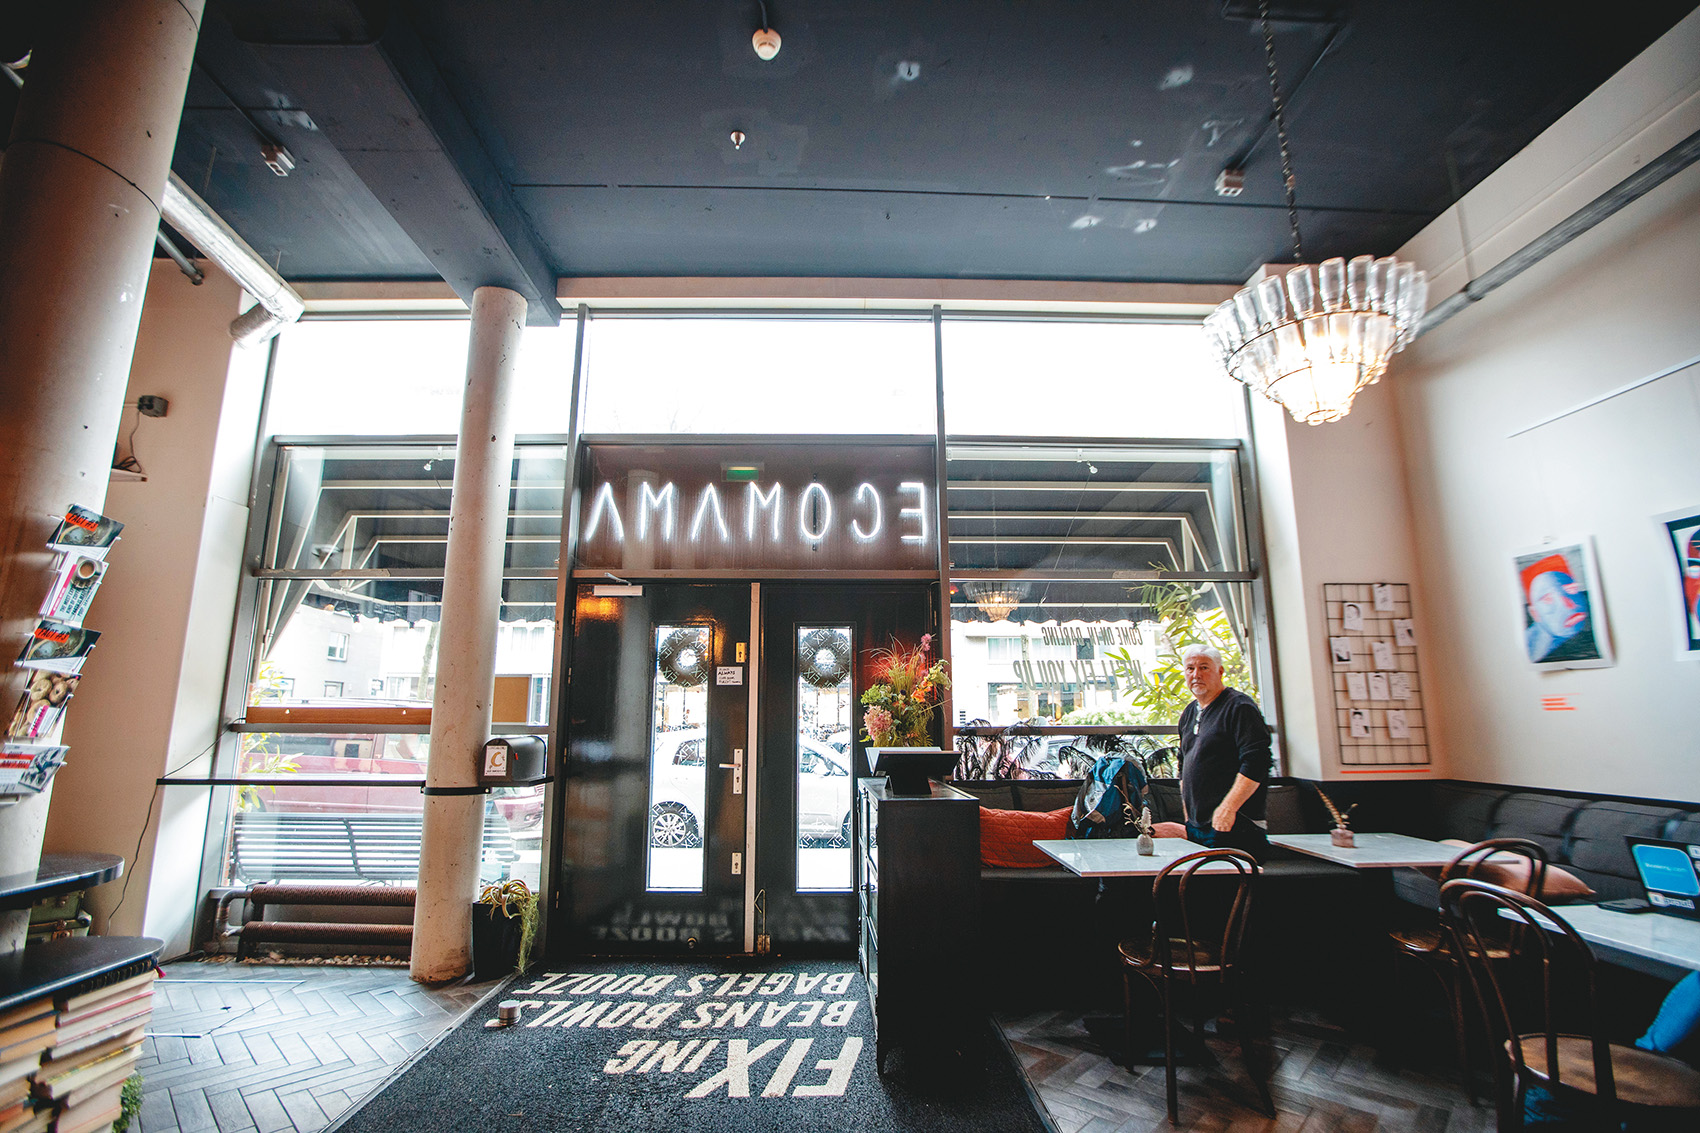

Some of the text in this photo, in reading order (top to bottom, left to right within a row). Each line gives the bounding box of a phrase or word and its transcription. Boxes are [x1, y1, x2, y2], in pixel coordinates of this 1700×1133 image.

[512, 972, 856, 997] BAGELS BOOZE
[680, 1000, 859, 1029] BEANS
